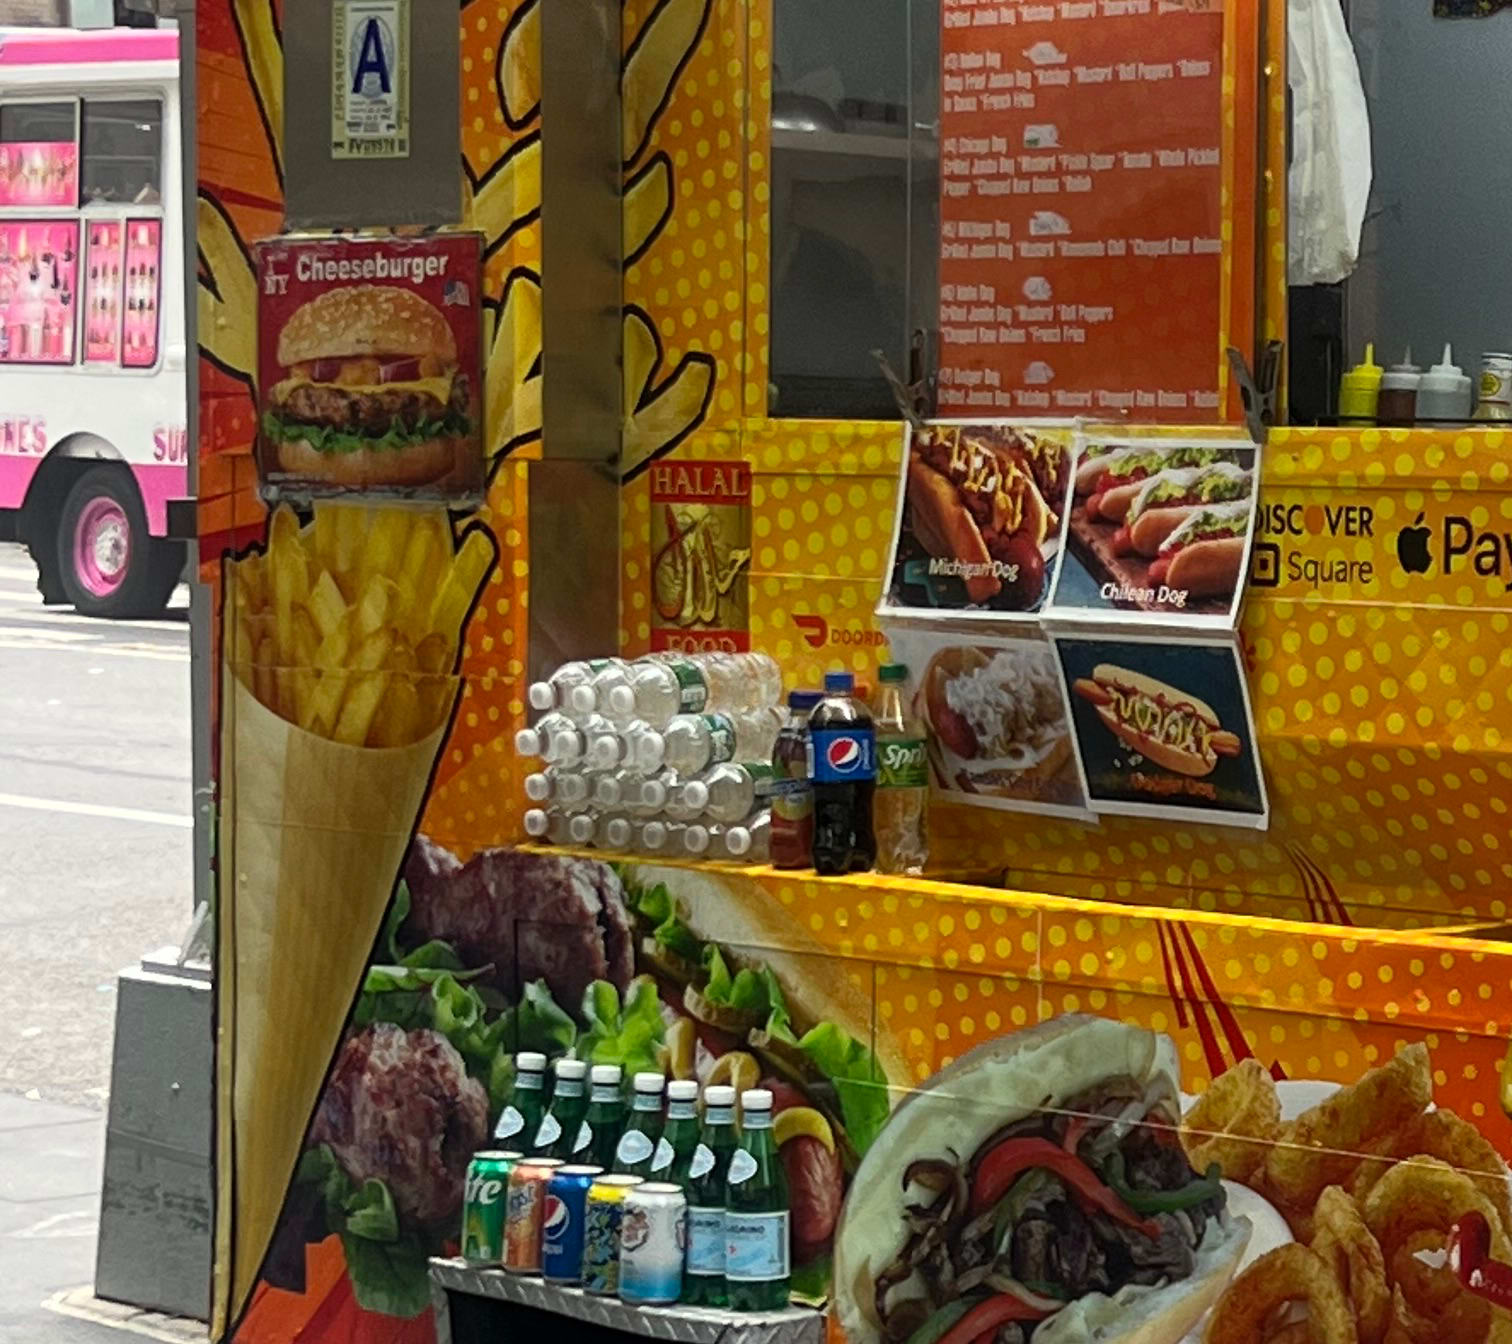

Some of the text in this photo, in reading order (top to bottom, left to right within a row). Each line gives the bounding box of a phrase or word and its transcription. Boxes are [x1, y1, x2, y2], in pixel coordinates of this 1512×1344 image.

[351, 19, 391, 93] A
[297, 252, 448, 284] Cheeseburger
[654, 466, 748, 497] HALAL
[929, 559, 1020, 582] Michigan Dog
[1287, 551, 1373, 589] Square
[1100, 583, 1189, 607] Chilean Dog
